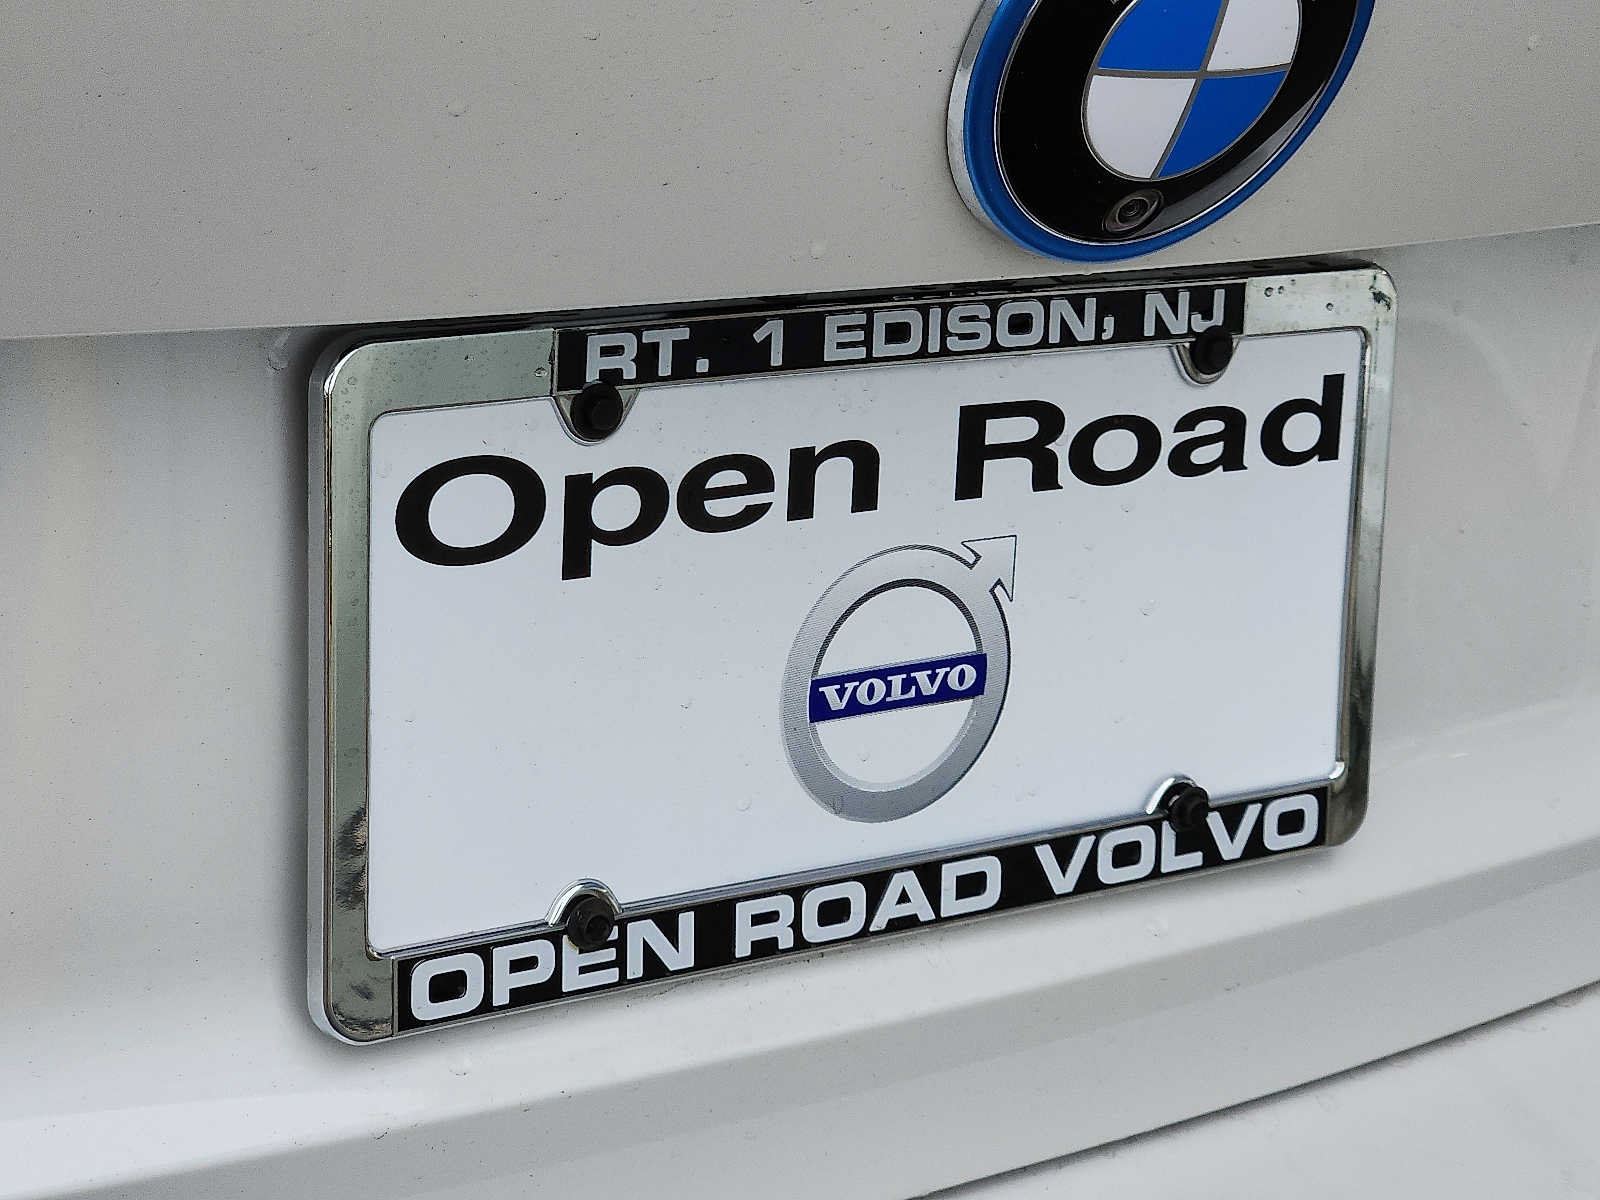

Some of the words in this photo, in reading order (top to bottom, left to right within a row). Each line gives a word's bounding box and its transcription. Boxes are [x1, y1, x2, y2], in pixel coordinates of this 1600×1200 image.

[585, 327, 709, 383] RT.
[753, 319, 783, 367] 1
[824, 297, 1114, 361] EDISON,
[1144, 288, 1225, 336] NJ
[395, 438, 880, 580] Open
[954, 373, 1345, 501] Road
[819, 664, 977, 711] VOLVO
[410, 911, 695, 1021] OPEN
[735, 856, 1002, 958] ROAD
[1034, 794, 1319, 895] VOLVO
